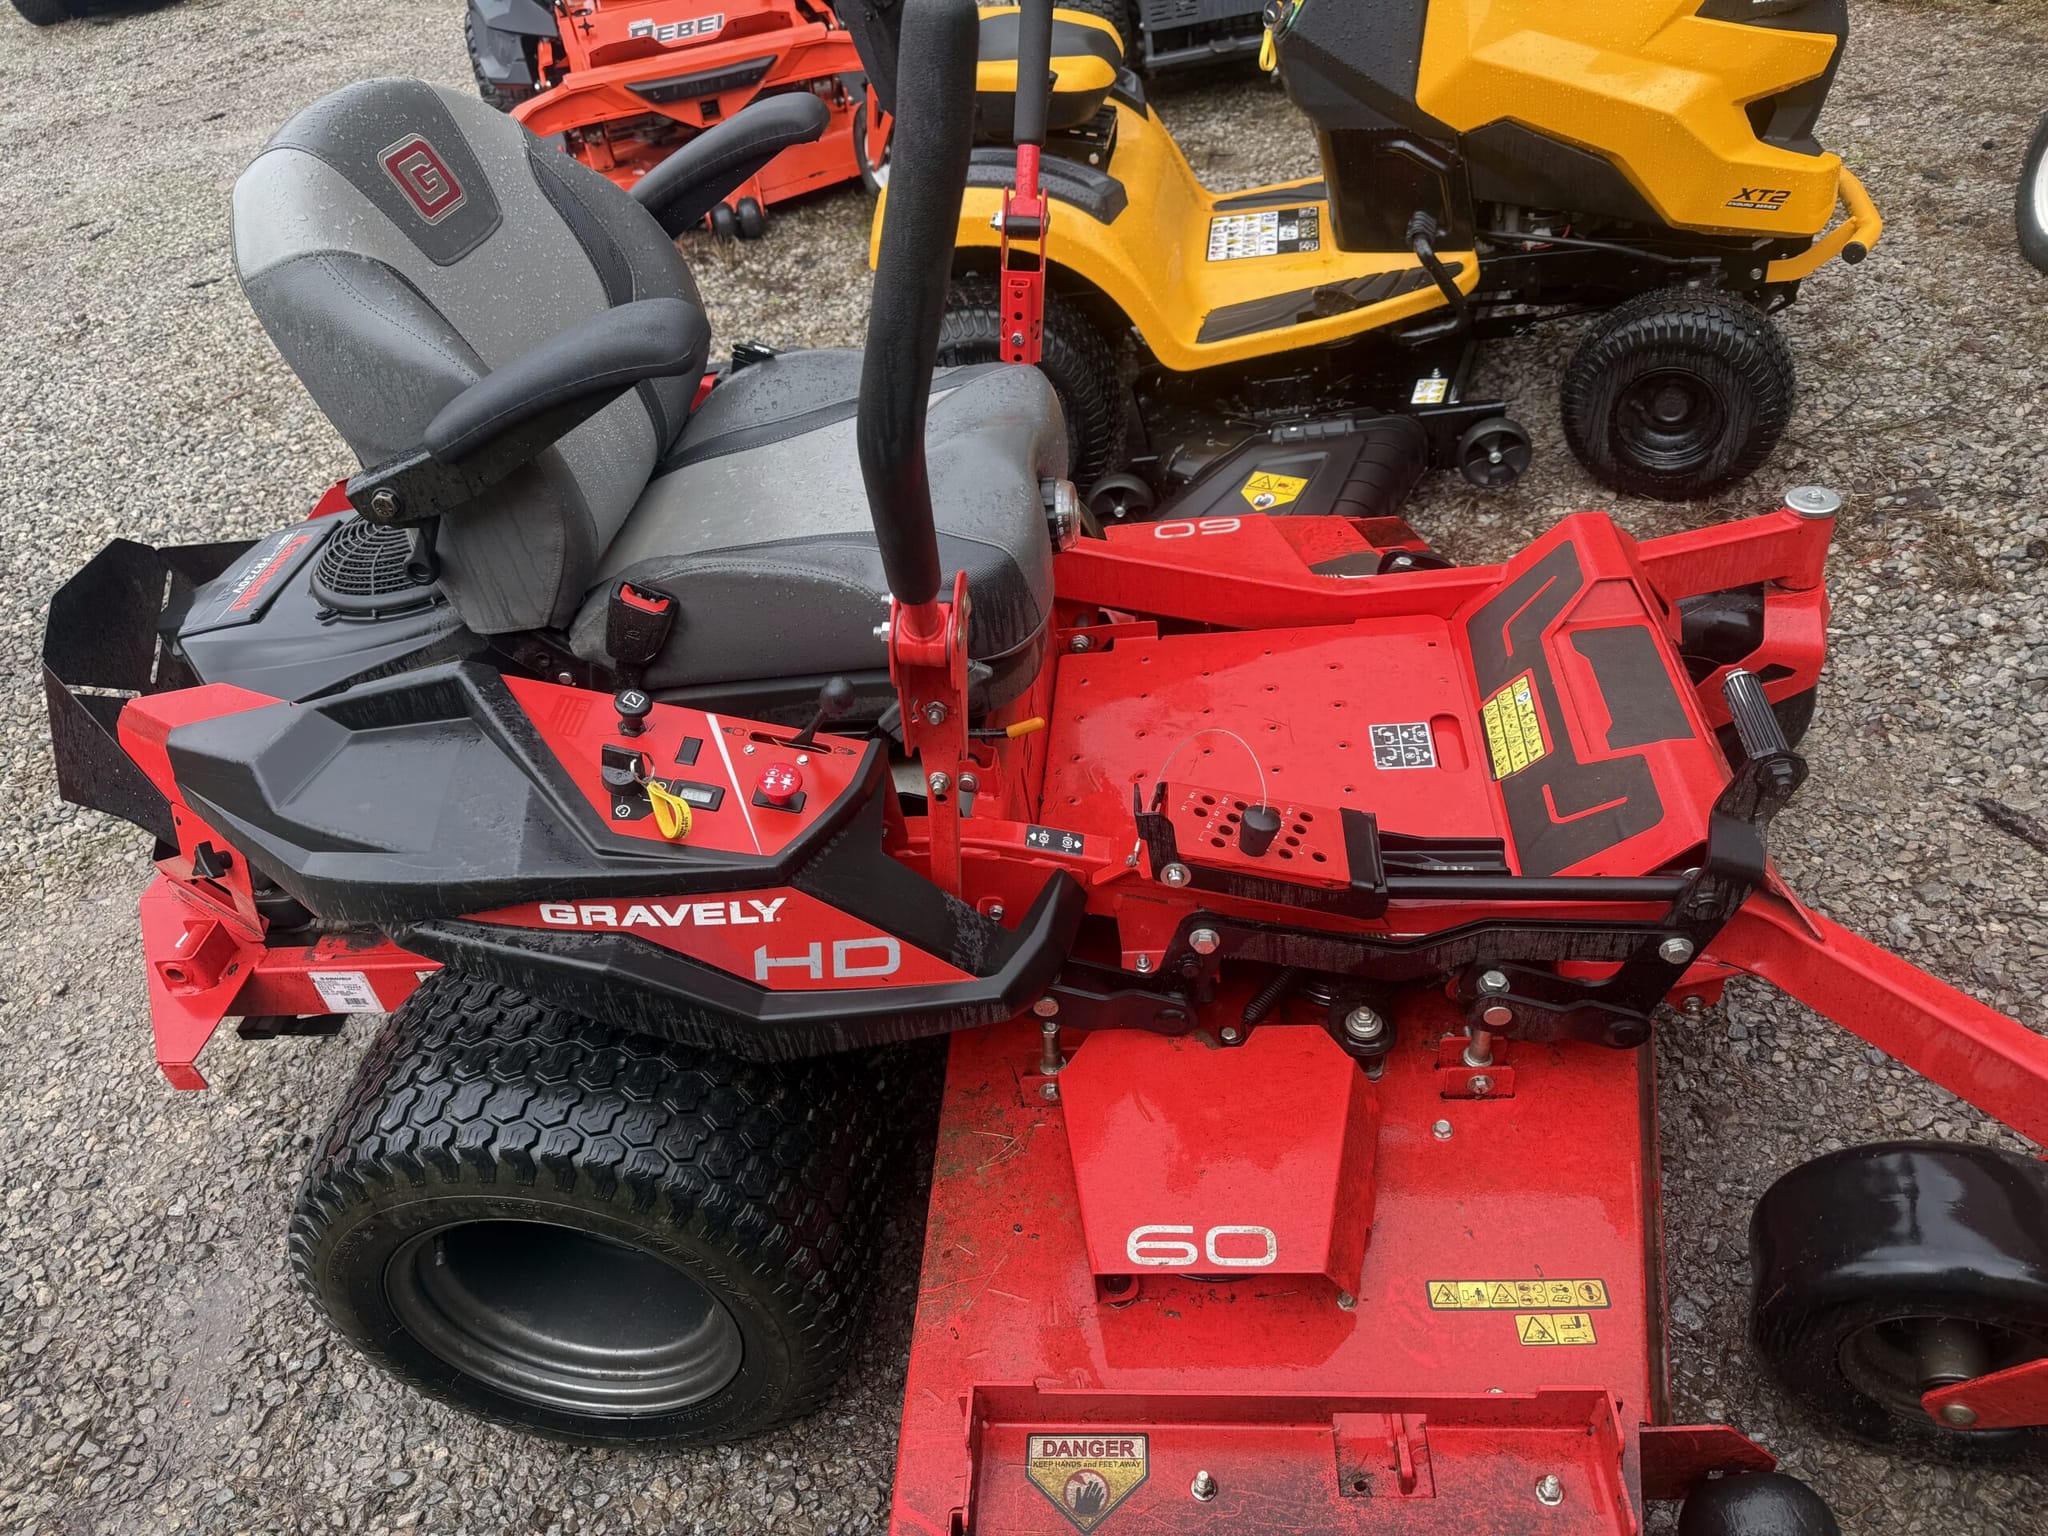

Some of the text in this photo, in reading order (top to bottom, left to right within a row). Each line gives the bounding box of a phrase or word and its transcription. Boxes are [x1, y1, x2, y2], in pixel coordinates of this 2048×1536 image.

[1732, 187, 1791, 204] XT2
[229, 533, 313, 612] Kawasaki
[539, 897, 787, 927] GRAVELY
[754, 937, 901, 981] HD
[1126, 1224, 1278, 1267] 60
[1032, 1460, 1142, 1468] KEEP HANDS and FEET AWAY
[1042, 1440, 1135, 1458] DANGER
